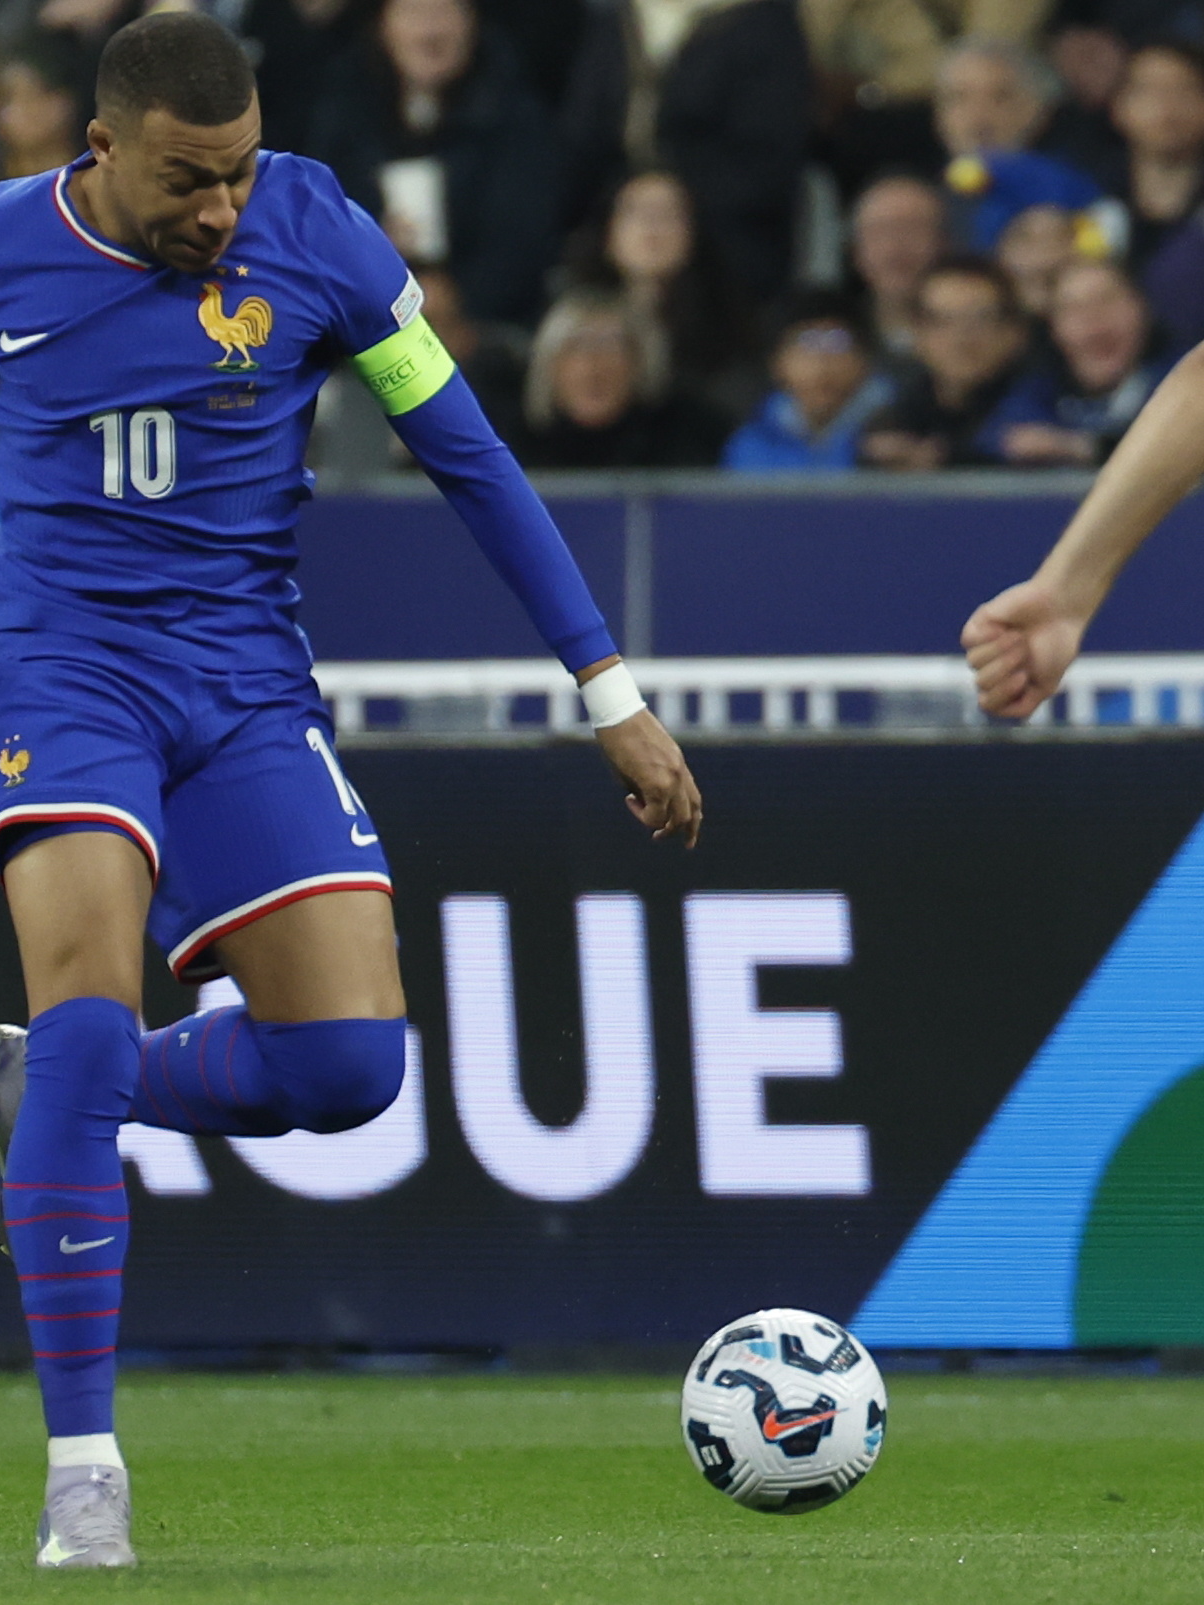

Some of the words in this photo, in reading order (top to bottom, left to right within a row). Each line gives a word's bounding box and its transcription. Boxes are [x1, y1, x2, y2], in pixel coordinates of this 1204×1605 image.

[369, 358, 416, 392] SPECT
[89, 408, 177, 500] 10
[305, 726, 368, 815] 1
